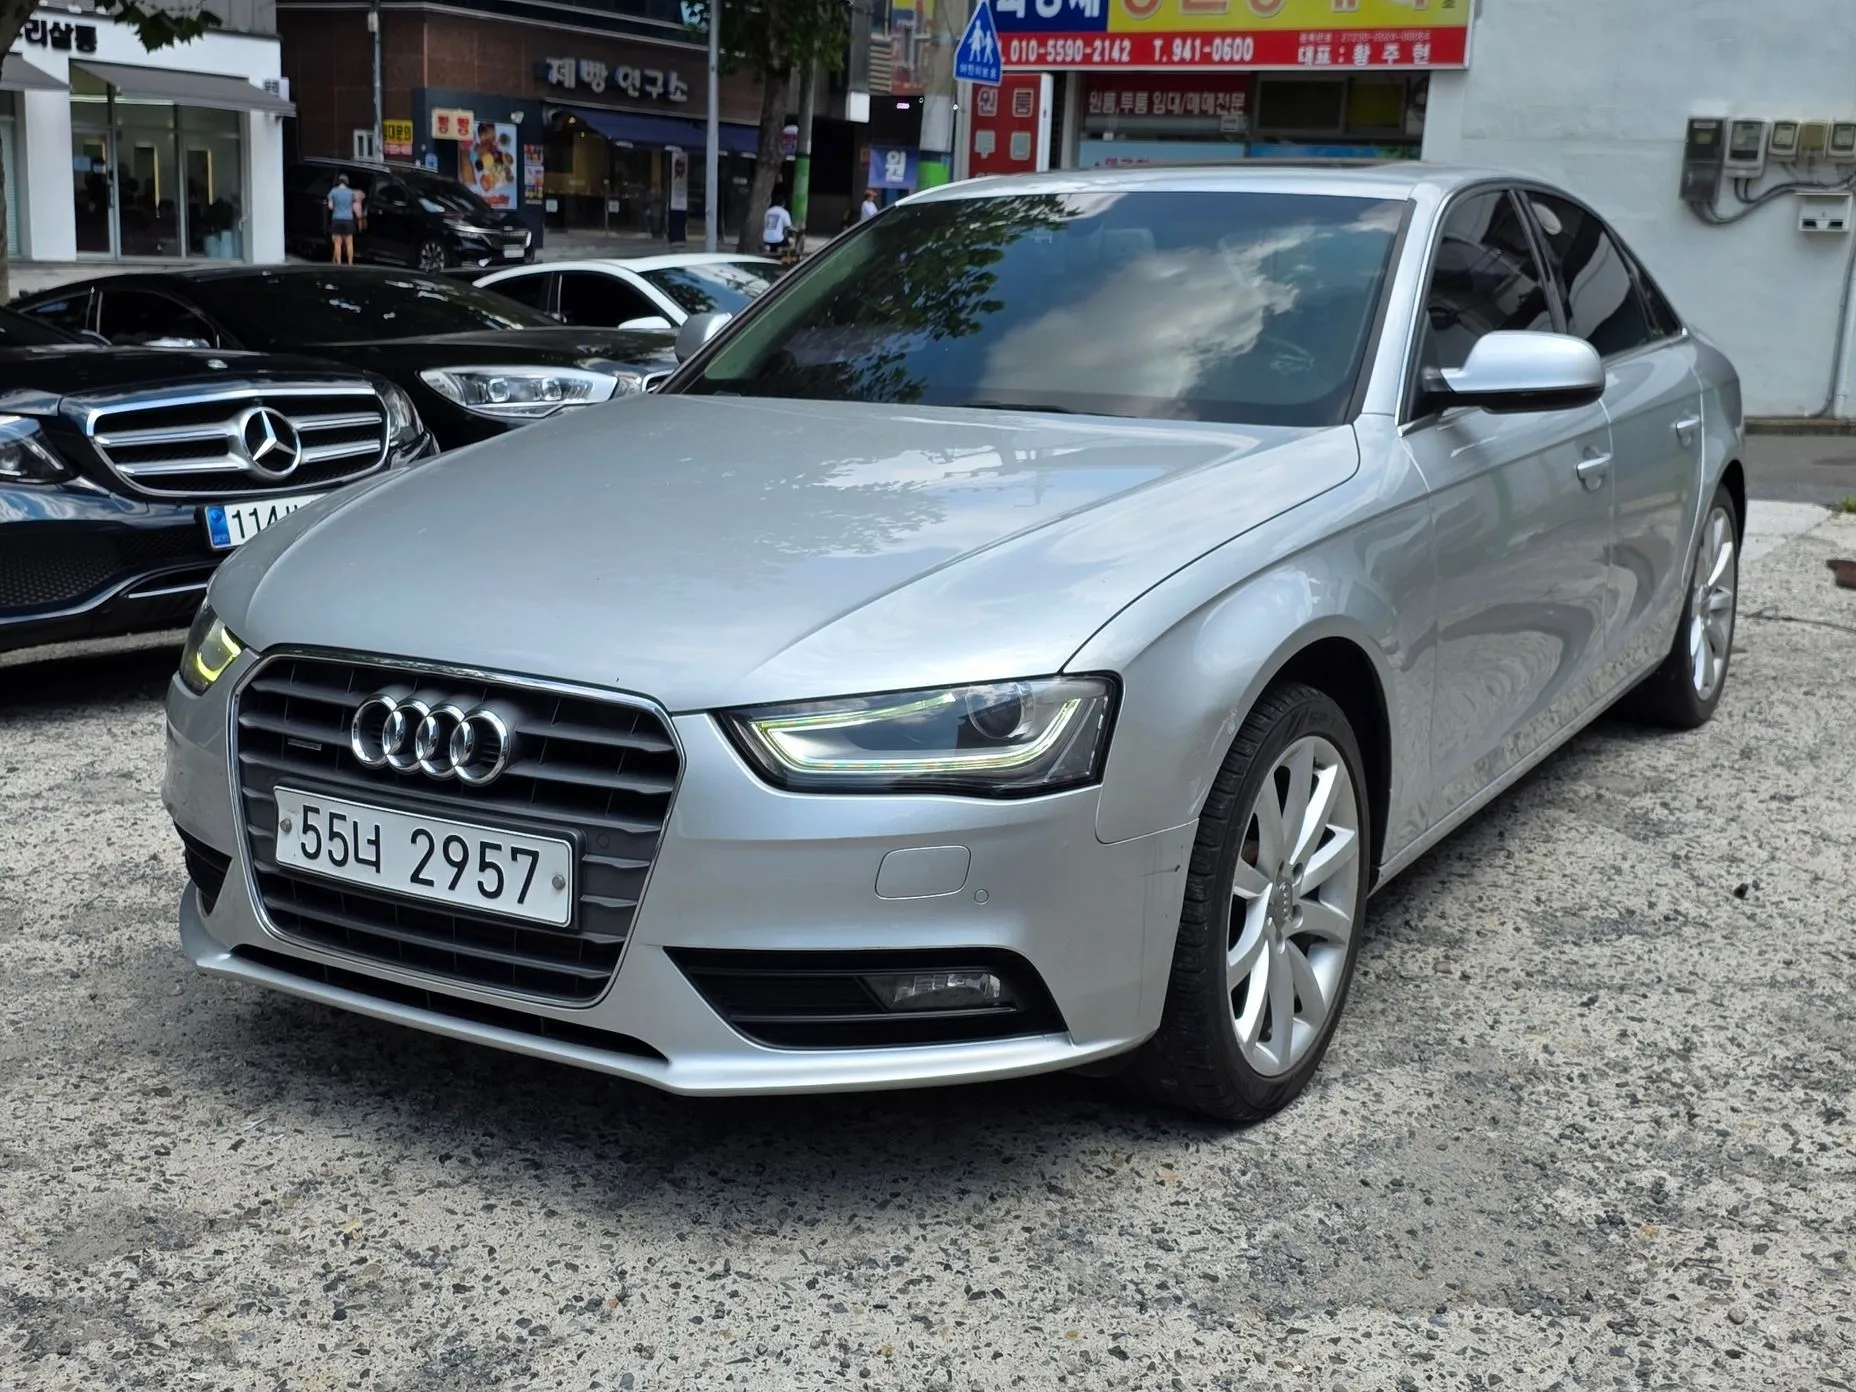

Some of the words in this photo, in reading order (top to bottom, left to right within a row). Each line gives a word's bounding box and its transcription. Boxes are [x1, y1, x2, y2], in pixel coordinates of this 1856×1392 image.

[546, 57, 608, 93] 제빵
[615, 65, 688, 102] 연구소
[300, 804, 381, 874] 55너
[409, 828, 540, 904] 2957
